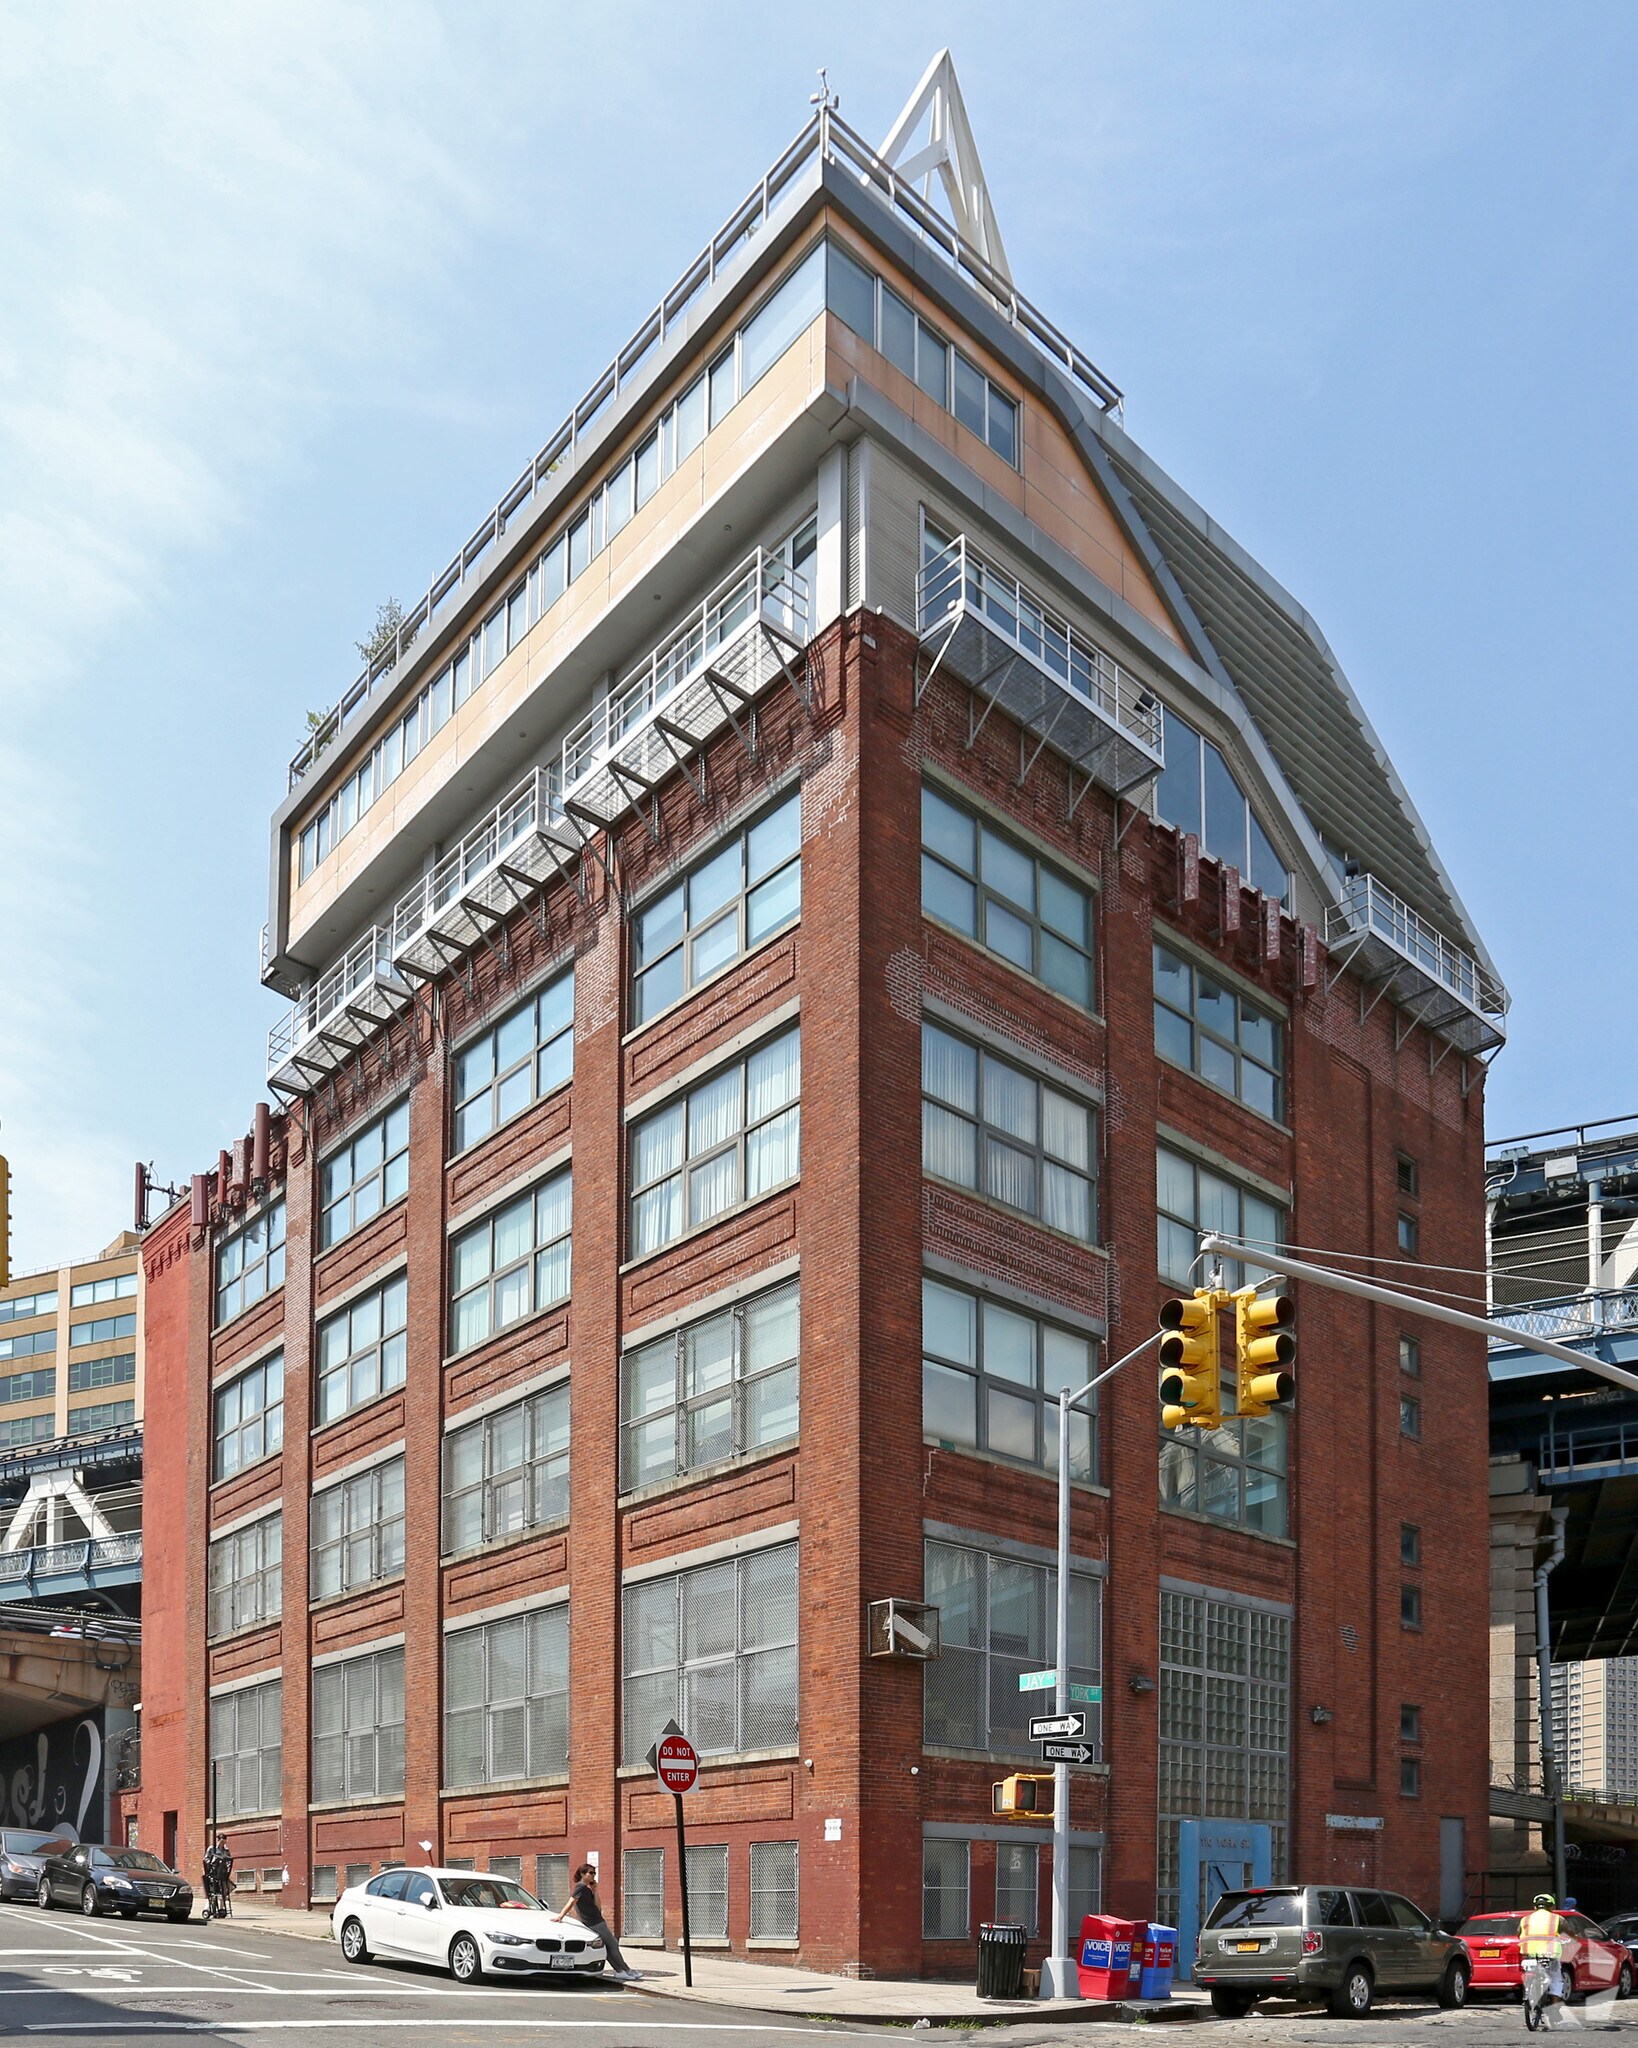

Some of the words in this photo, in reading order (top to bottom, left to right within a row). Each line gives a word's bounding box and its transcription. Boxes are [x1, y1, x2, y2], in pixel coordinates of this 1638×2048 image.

[1024, 1674, 1045, 1688] JAY
[1047, 1672, 1054, 1680] ST
[1070, 1686, 1089, 1700] YORK
[1037, 1723, 1053, 1733] ONE
[1060, 1721, 1076, 1731] WAY
[662, 1746, 673, 1756] DO
[676, 1747, 690, 1757] NOT
[1049, 1747, 1065, 1756] ONE
[1071, 1749, 1087, 1758] WAY
[667, 1772, 690, 1782] ENTER
[1086, 1941, 1110, 1952] VOICE
[1115, 1942, 1131, 1952] VOICE
